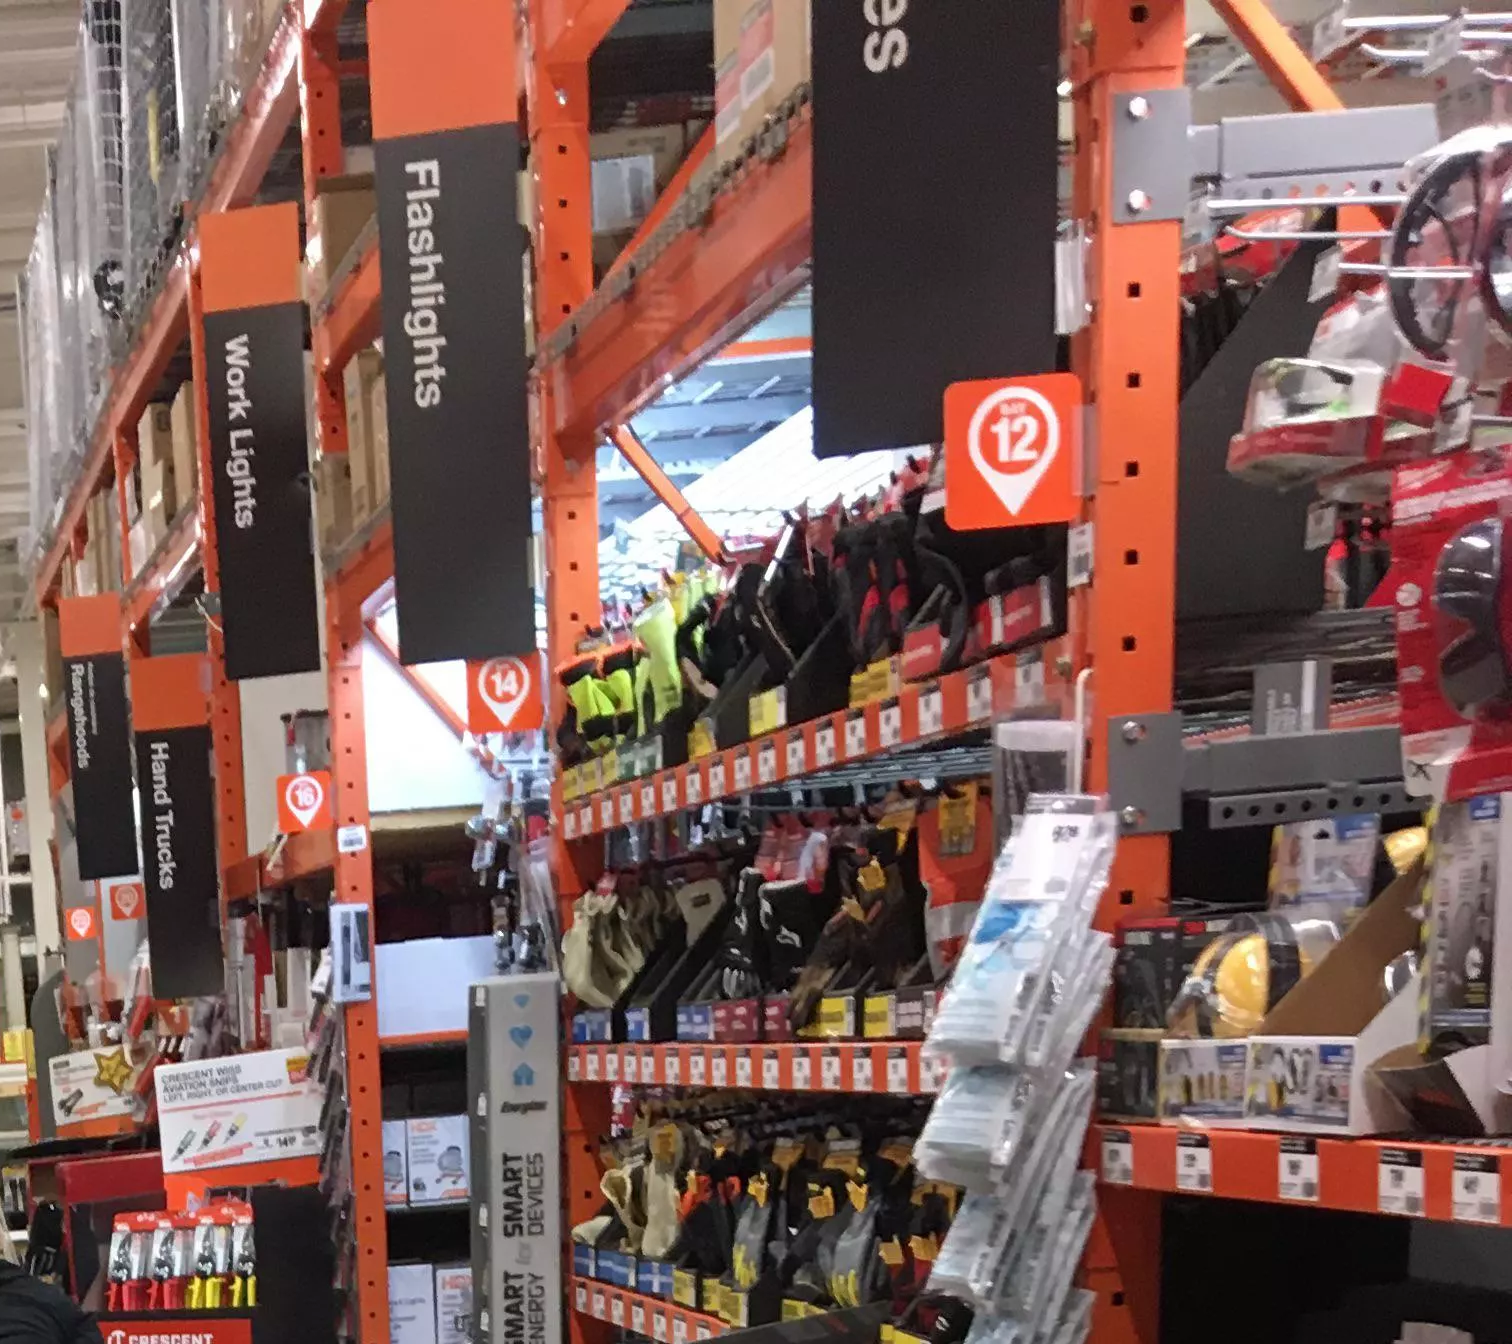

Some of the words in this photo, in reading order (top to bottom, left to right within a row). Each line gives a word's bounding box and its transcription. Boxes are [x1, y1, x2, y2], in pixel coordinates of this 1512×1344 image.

[404, 159, 447, 408] Flashlights
[225, 333, 252, 421] Work
[226, 428, 257, 529] Lights
[990, 415, 1039, 462] 12
[70, 663, 90, 769] Rangehoods
[491, 670, 518, 698] 14
[150, 741, 174, 805] Hand
[156, 809, 177, 891] Trucks
[161, 1067, 213, 1083] CRESCENT
[163, 1080, 206, 1093] AVIATION
[502, 1153, 524, 1238] SMART
[526, 1152, 545, 1237] DEVICES
